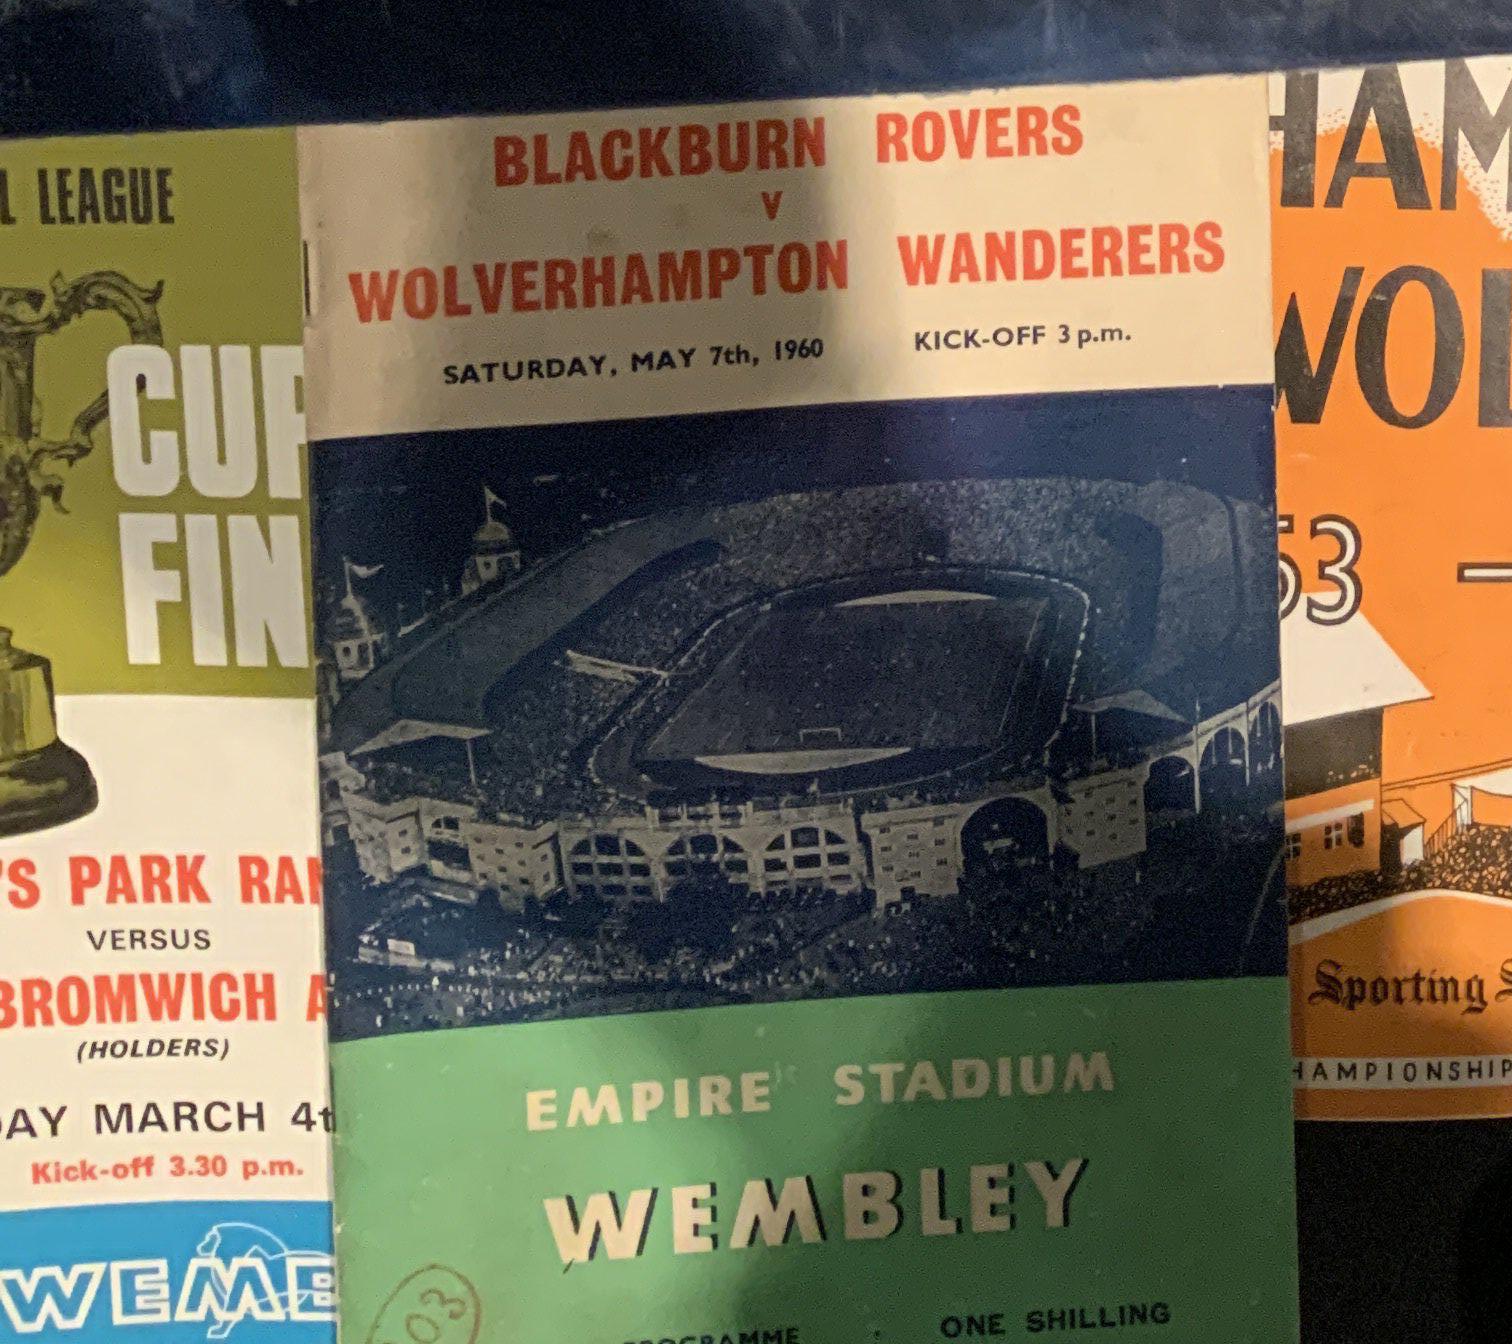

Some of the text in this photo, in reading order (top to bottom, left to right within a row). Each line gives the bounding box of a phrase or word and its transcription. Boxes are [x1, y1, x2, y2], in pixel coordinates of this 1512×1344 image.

[494, 104, 1083, 187] BLACKBURN ROVERS
[37, 166, 175, 225] LEAGUE
[348, 221, 1225, 323] WOLVERHAMPTON WANDERERS
[443, 324, 1131, 385] SATURDAY, MAY 7th, 1960 KICK-OFF 3 p.m.
[69, 854, 211, 906] PARK
[86, 928, 211, 951] VERSUS
[1308, 958, 1488, 1015] Sporting
[76, 1038, 229, 1063] (HOLDERS)
[0, 1105, 67, 1139] AY
[95, 1101, 265, 1135] MARCH
[525, 1050, 1115, 1133] EMPIRE STADIUM
[31, 1155, 304, 1185] Kick-off 3.30 p.m.
[543, 1158, 1090, 1266] WEMBLEY
[940, 1302, 1172, 1341] ONE SHILLING
